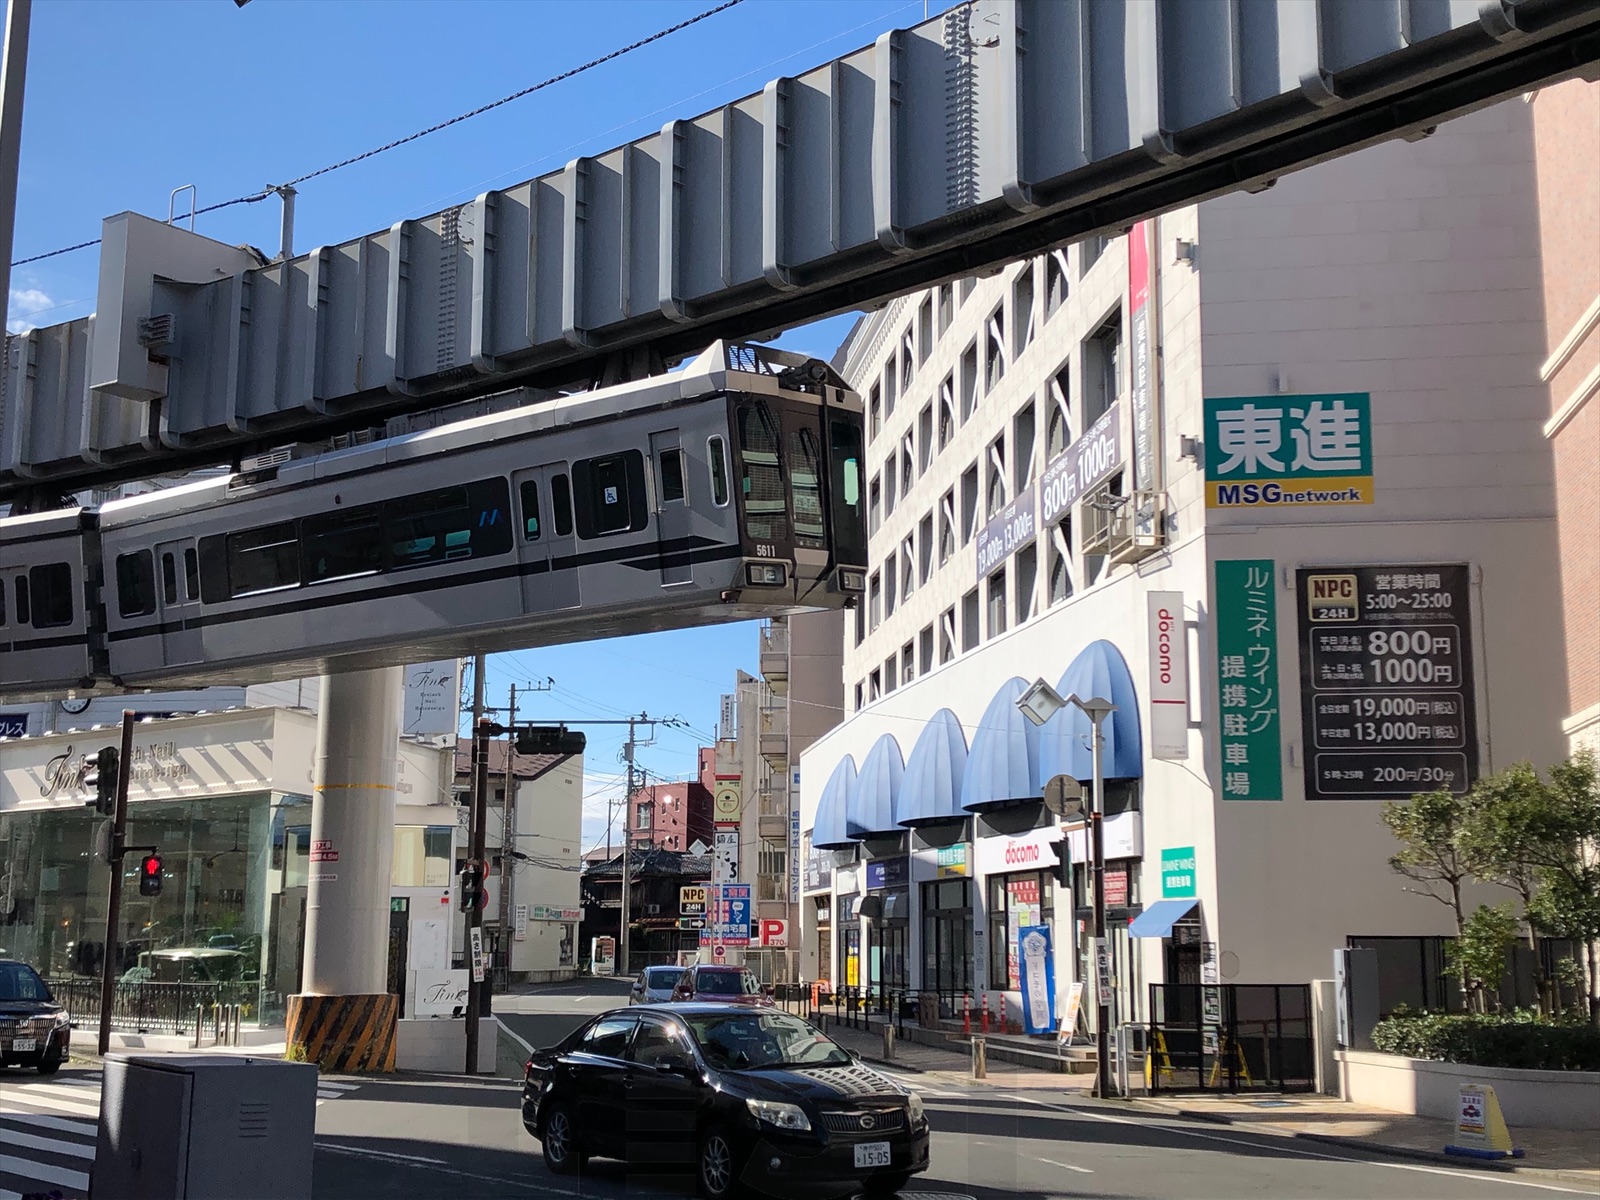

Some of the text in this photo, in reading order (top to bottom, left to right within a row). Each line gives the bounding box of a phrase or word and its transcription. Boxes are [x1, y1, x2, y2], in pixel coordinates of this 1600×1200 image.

[1216, 400, 1361, 474] 東進
[1078, 434, 1115, 489] 1000円
[1043, 471, 1076, 521] 800円
[756, 544, 776, 557] 5611
[1313, 580, 1352, 598] NPC
[1375, 574, 1441, 590] 営業時間
[1319, 608, 1349, 619] 24H
[1158, 608, 1174, 684] docomo
[1368, 630, 1451, 655] 800円
[1370, 658, 1452, 683] 1000円
[1221, 655, 1250, 796] 提携駐車場
[1005, 841, 1039, 865] docomo
[683, 889, 705, 900] NPC
[764, 920, 784, 945] P
[473, 933, 482, 967] 高さ制限
[863, 1151, 889, 1165] 15-05
